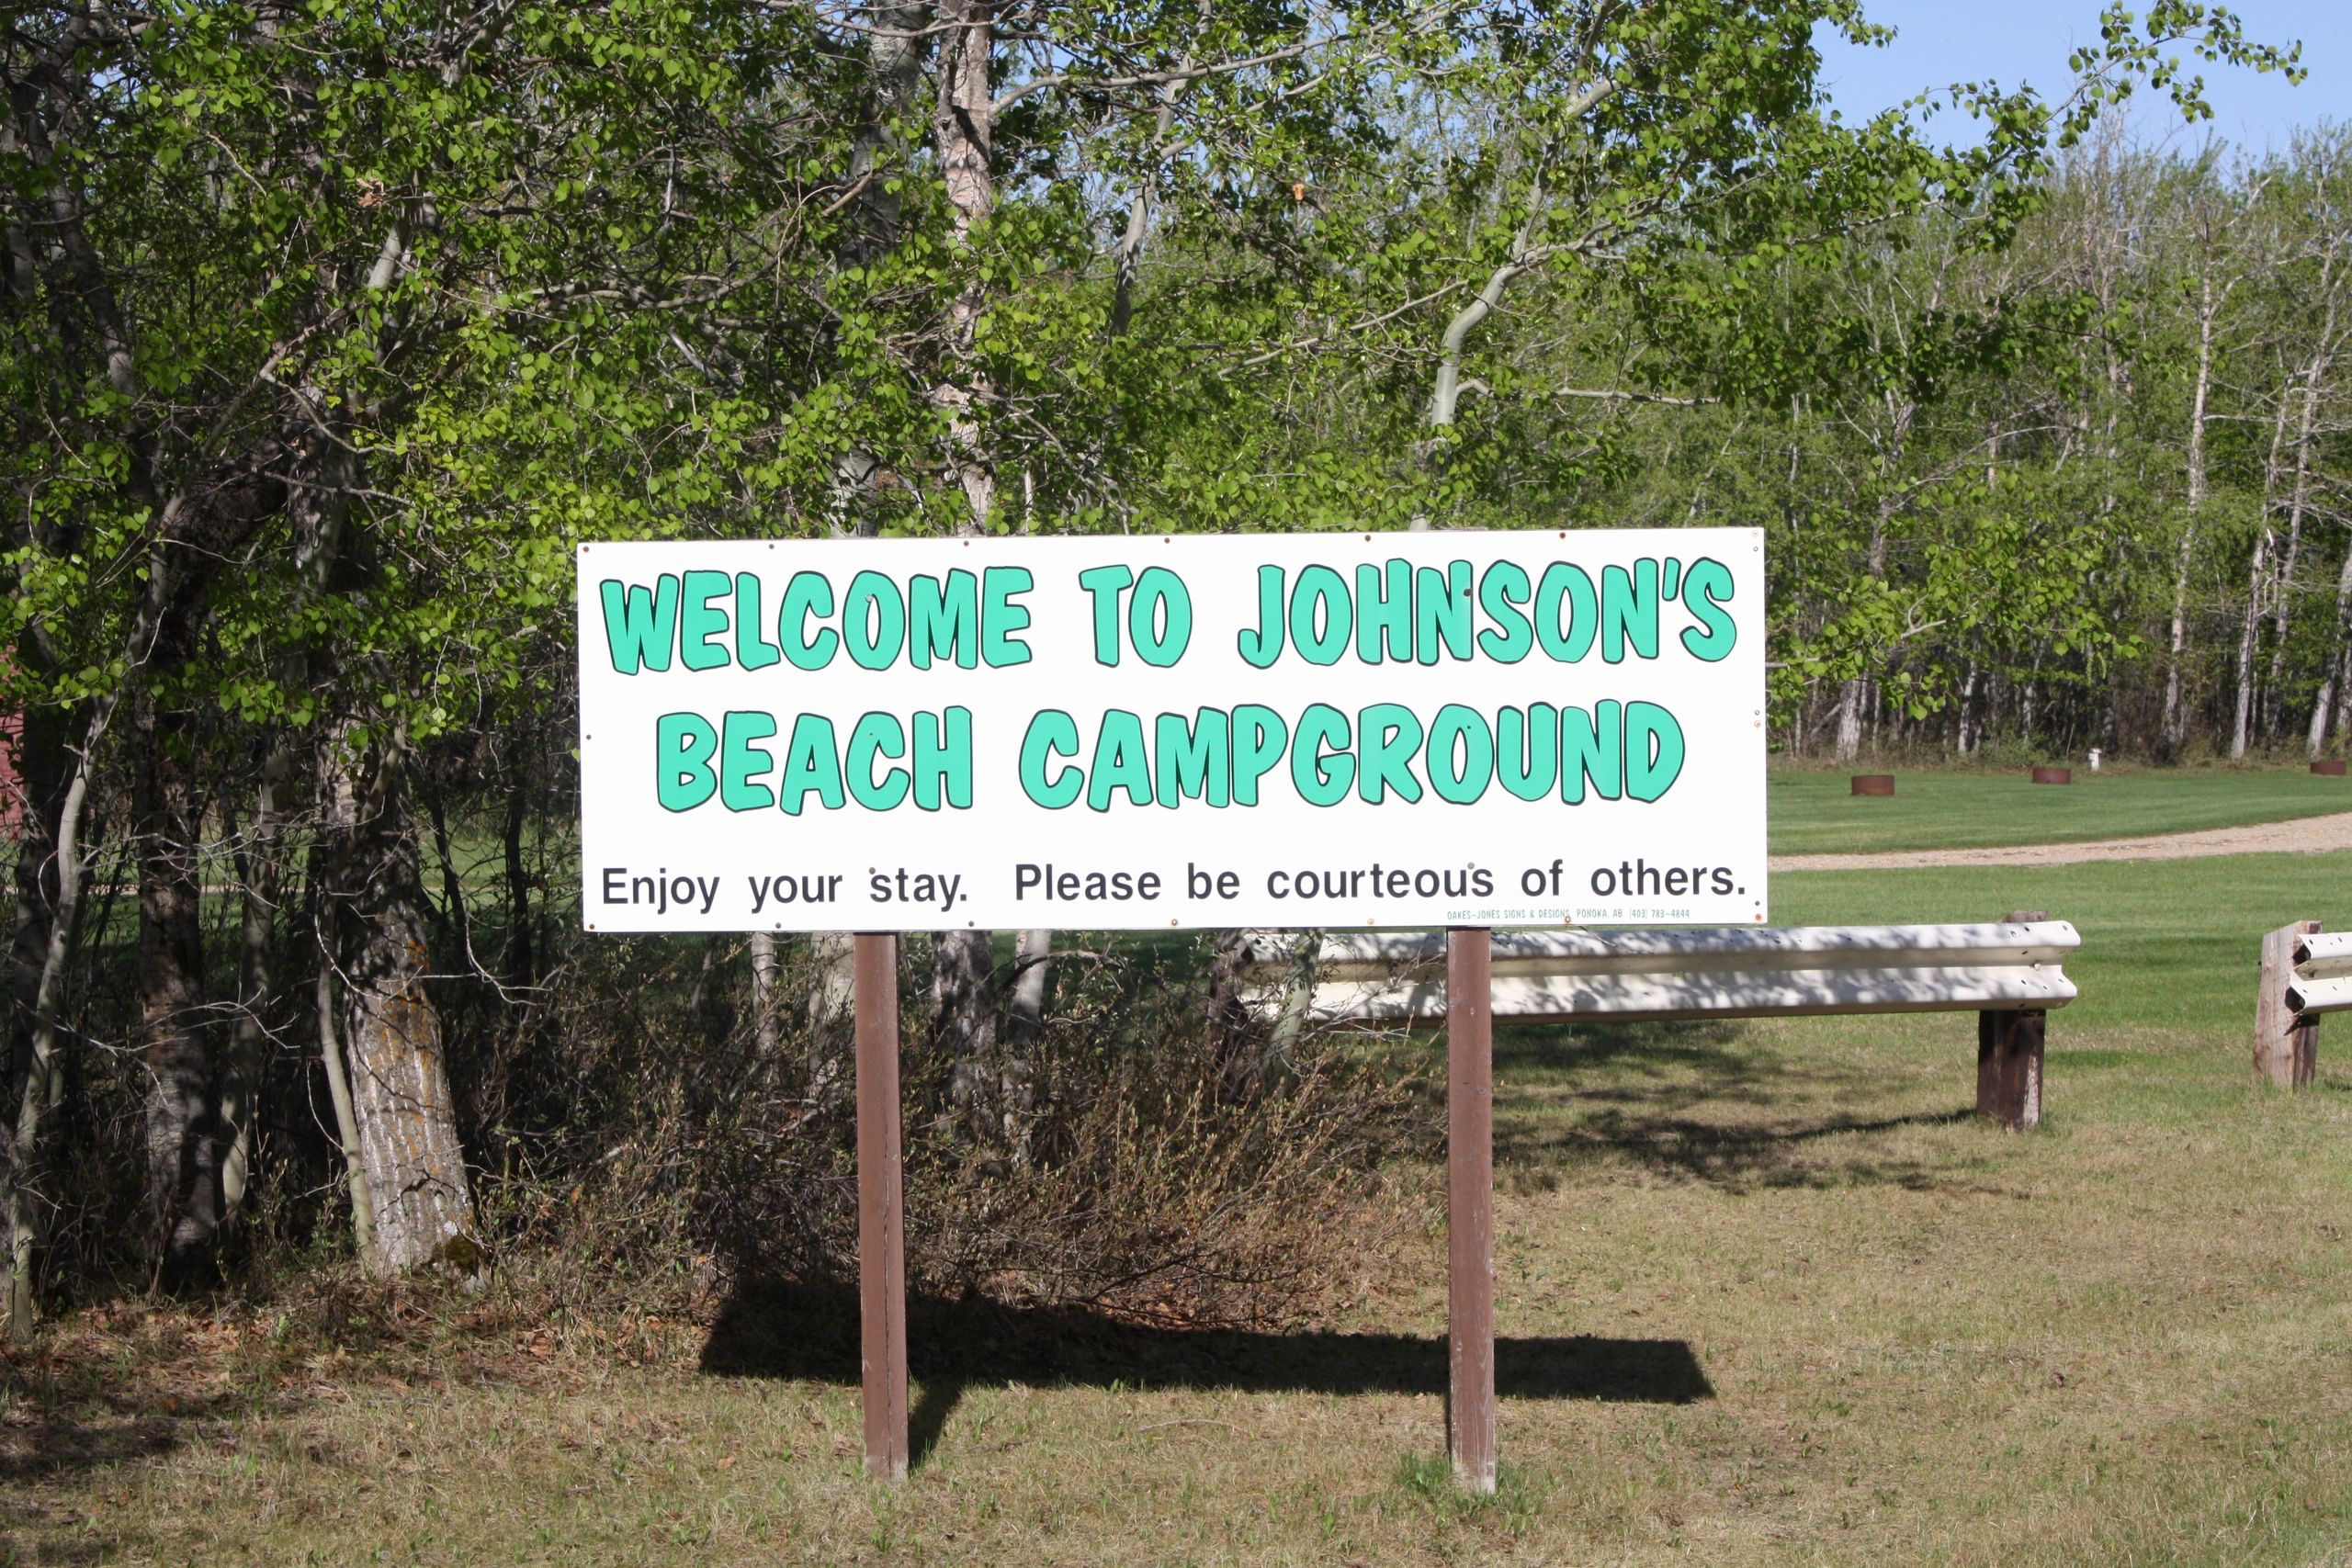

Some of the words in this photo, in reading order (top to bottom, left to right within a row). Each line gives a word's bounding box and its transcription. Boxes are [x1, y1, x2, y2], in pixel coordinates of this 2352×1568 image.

[599, 565, 1035, 676] WELCOME
[1079, 564, 1193, 668] TO
[1237, 556, 1737, 670] JOHNSON'S
[656, 705, 974, 817] BEACH
[1018, 699, 1686, 814] CAMPGROUND
[603, 867, 720, 915] Enjoy
[748, 874, 843, 914] your
[870, 868, 967, 912] stay.
[1015, 863, 1161, 901] Please
[1187, 862, 1240, 900] be
[1267, 863, 1494, 899] courteous
[1521, 859, 1564, 897] of
[1590, 858, 1745, 897] others.
[1447, 909, 1500, 920] OAKES-JONES
[1504, 909, 1526, 919] SIGNS
[1529, 909, 1535, 919] &
[1538, 908, 1570, 919] DESIGNS
[1612, 908, 1623, 919] AB
[1629, 908, 1648, 920] (403)
[1651, 908, 1690, 919] 783-4844
